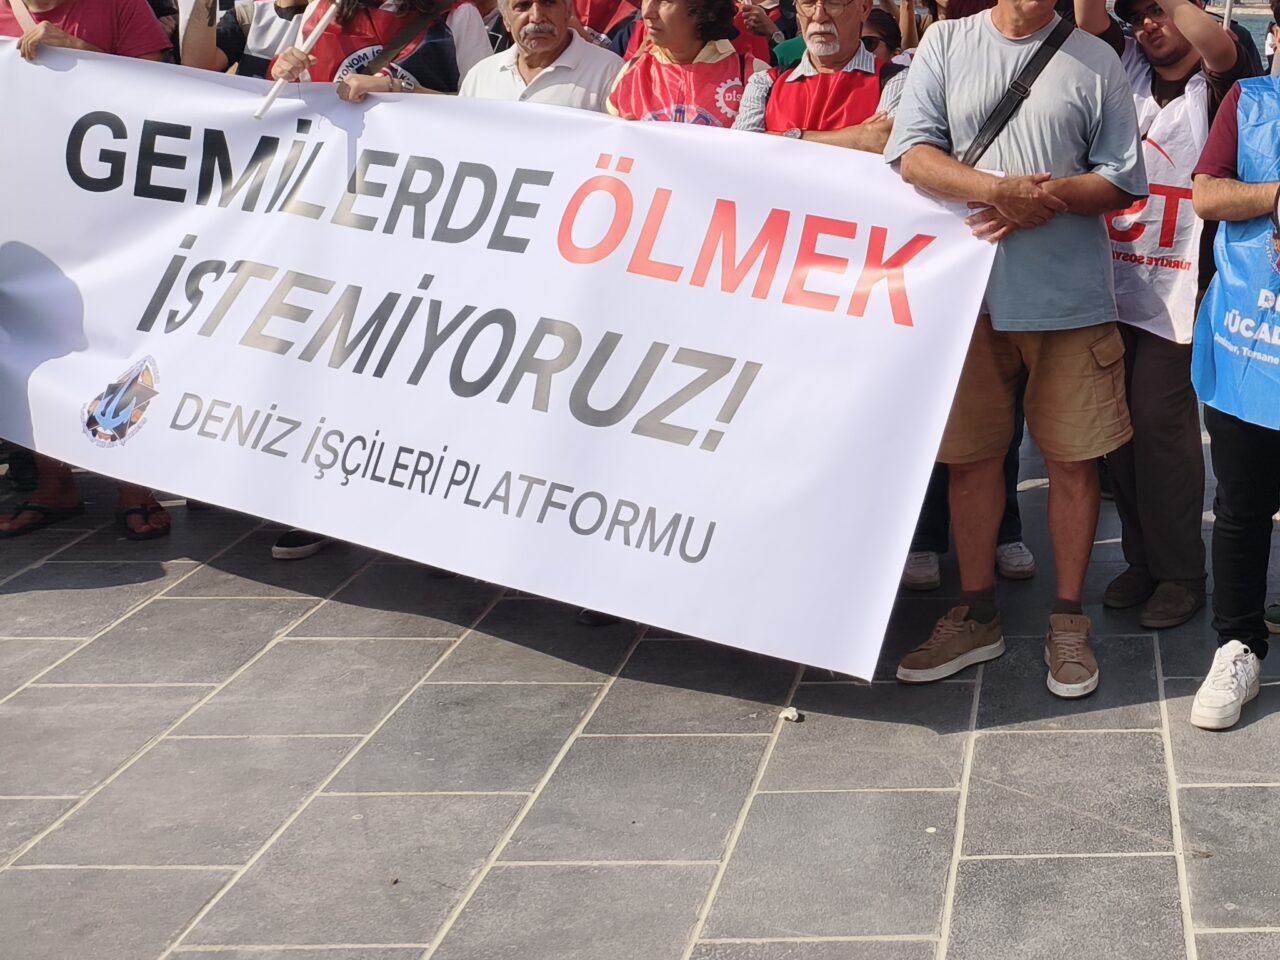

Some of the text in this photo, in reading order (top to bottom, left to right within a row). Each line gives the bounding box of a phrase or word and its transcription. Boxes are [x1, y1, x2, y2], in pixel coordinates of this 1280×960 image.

[65, 110, 937, 328] GEMİLERDE ÖLMEK
[136, 234, 763, 453] İSTEMİYORUZ!
[169, 392, 302, 458] DENİZ
[302, 416, 449, 497] İŞÇİLERİ
[444, 463, 717, 564] PLATFORMU
